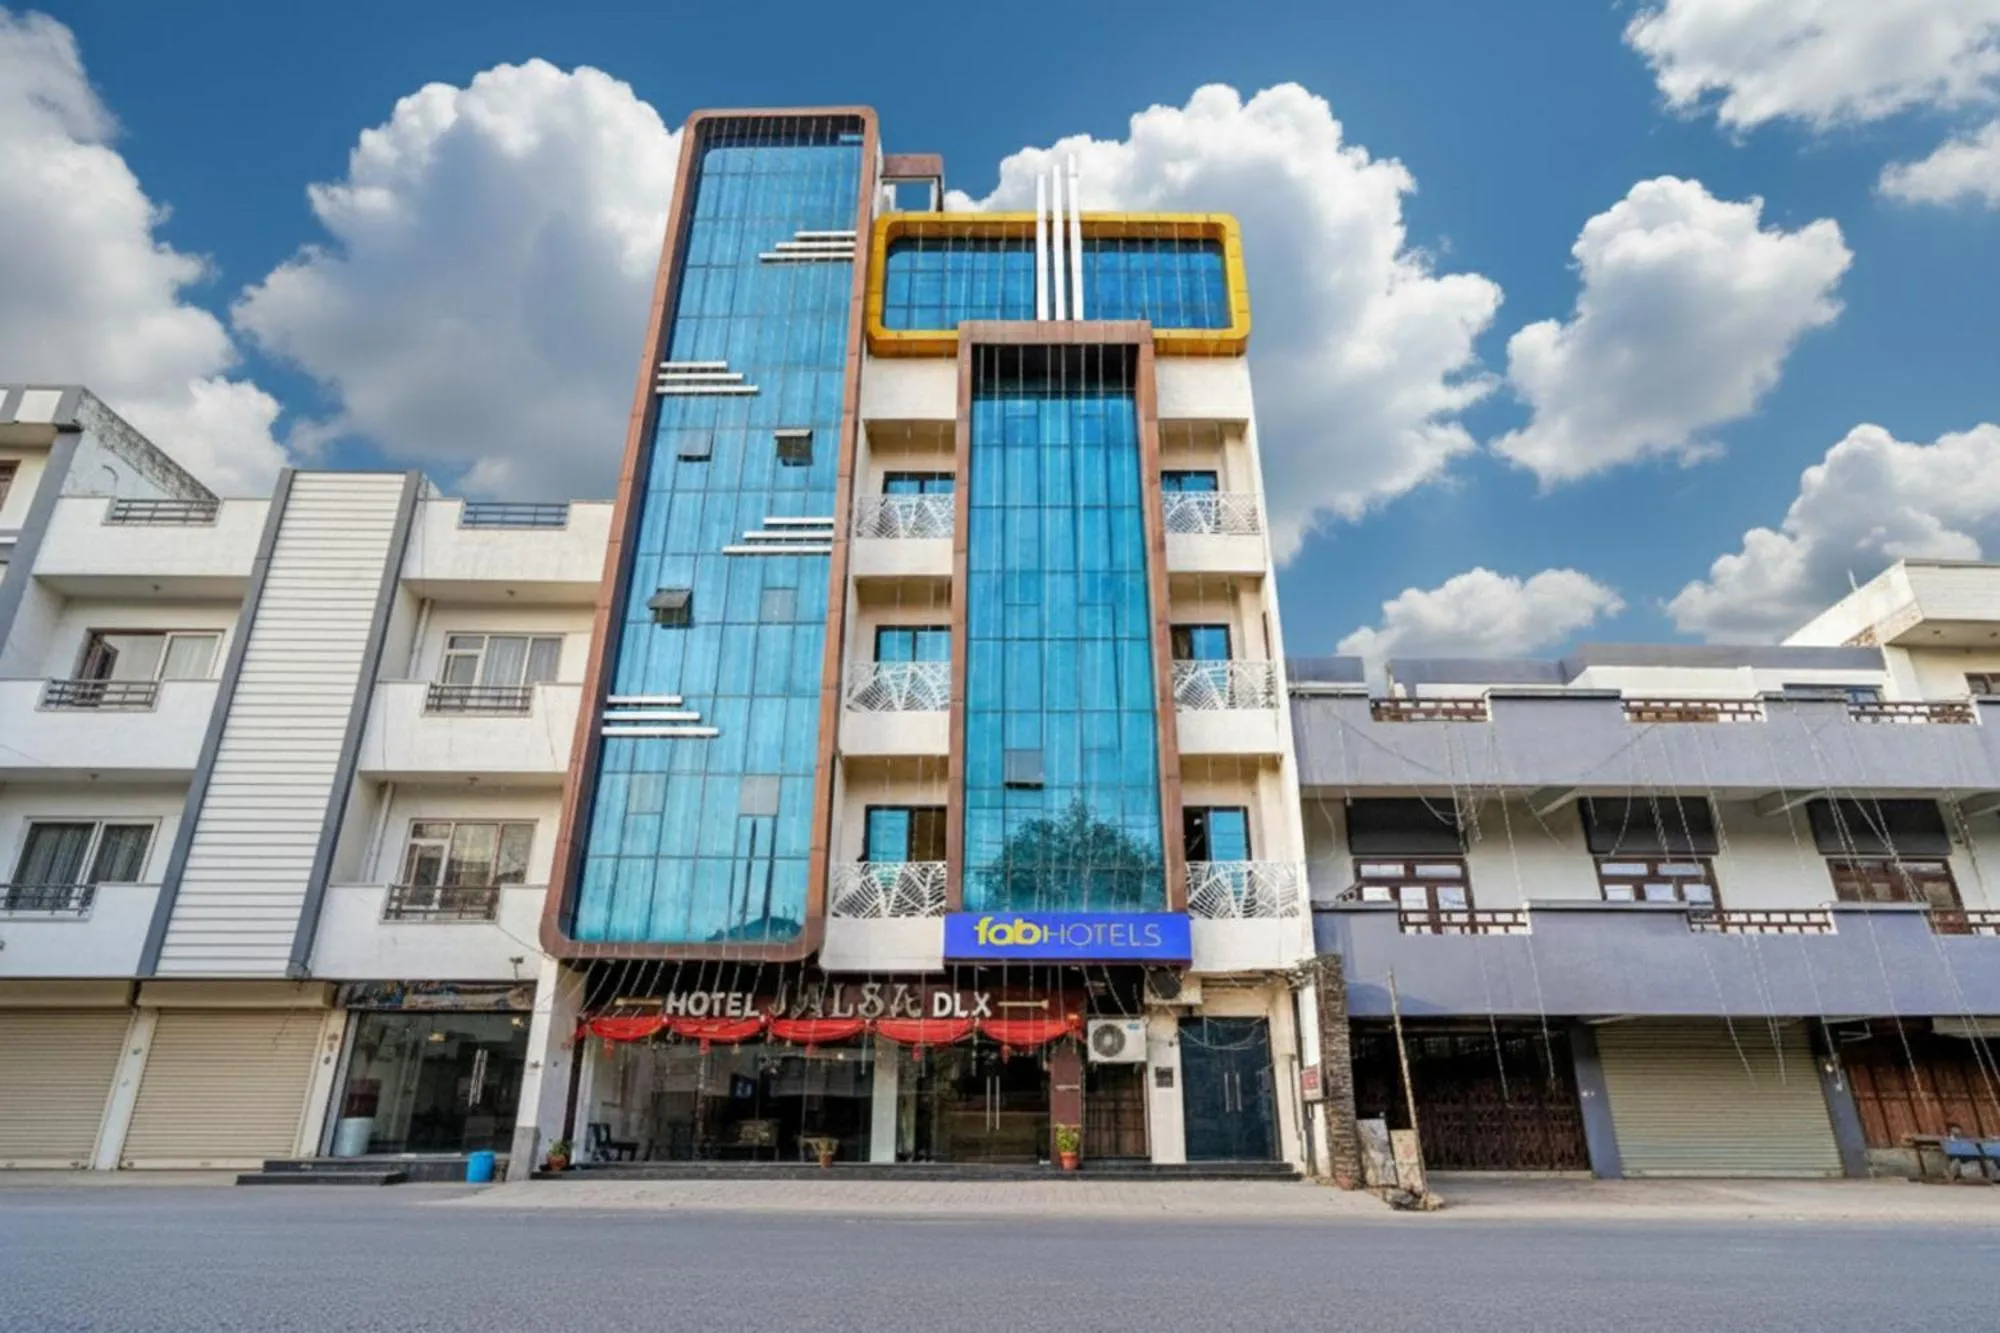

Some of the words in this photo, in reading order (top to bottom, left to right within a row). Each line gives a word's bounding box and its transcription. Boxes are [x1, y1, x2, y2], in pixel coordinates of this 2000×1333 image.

[666, 991, 760, 1018] HOTEL
[767, 983, 922, 1018] JALSA
[932, 991, 992, 1018] DLX
